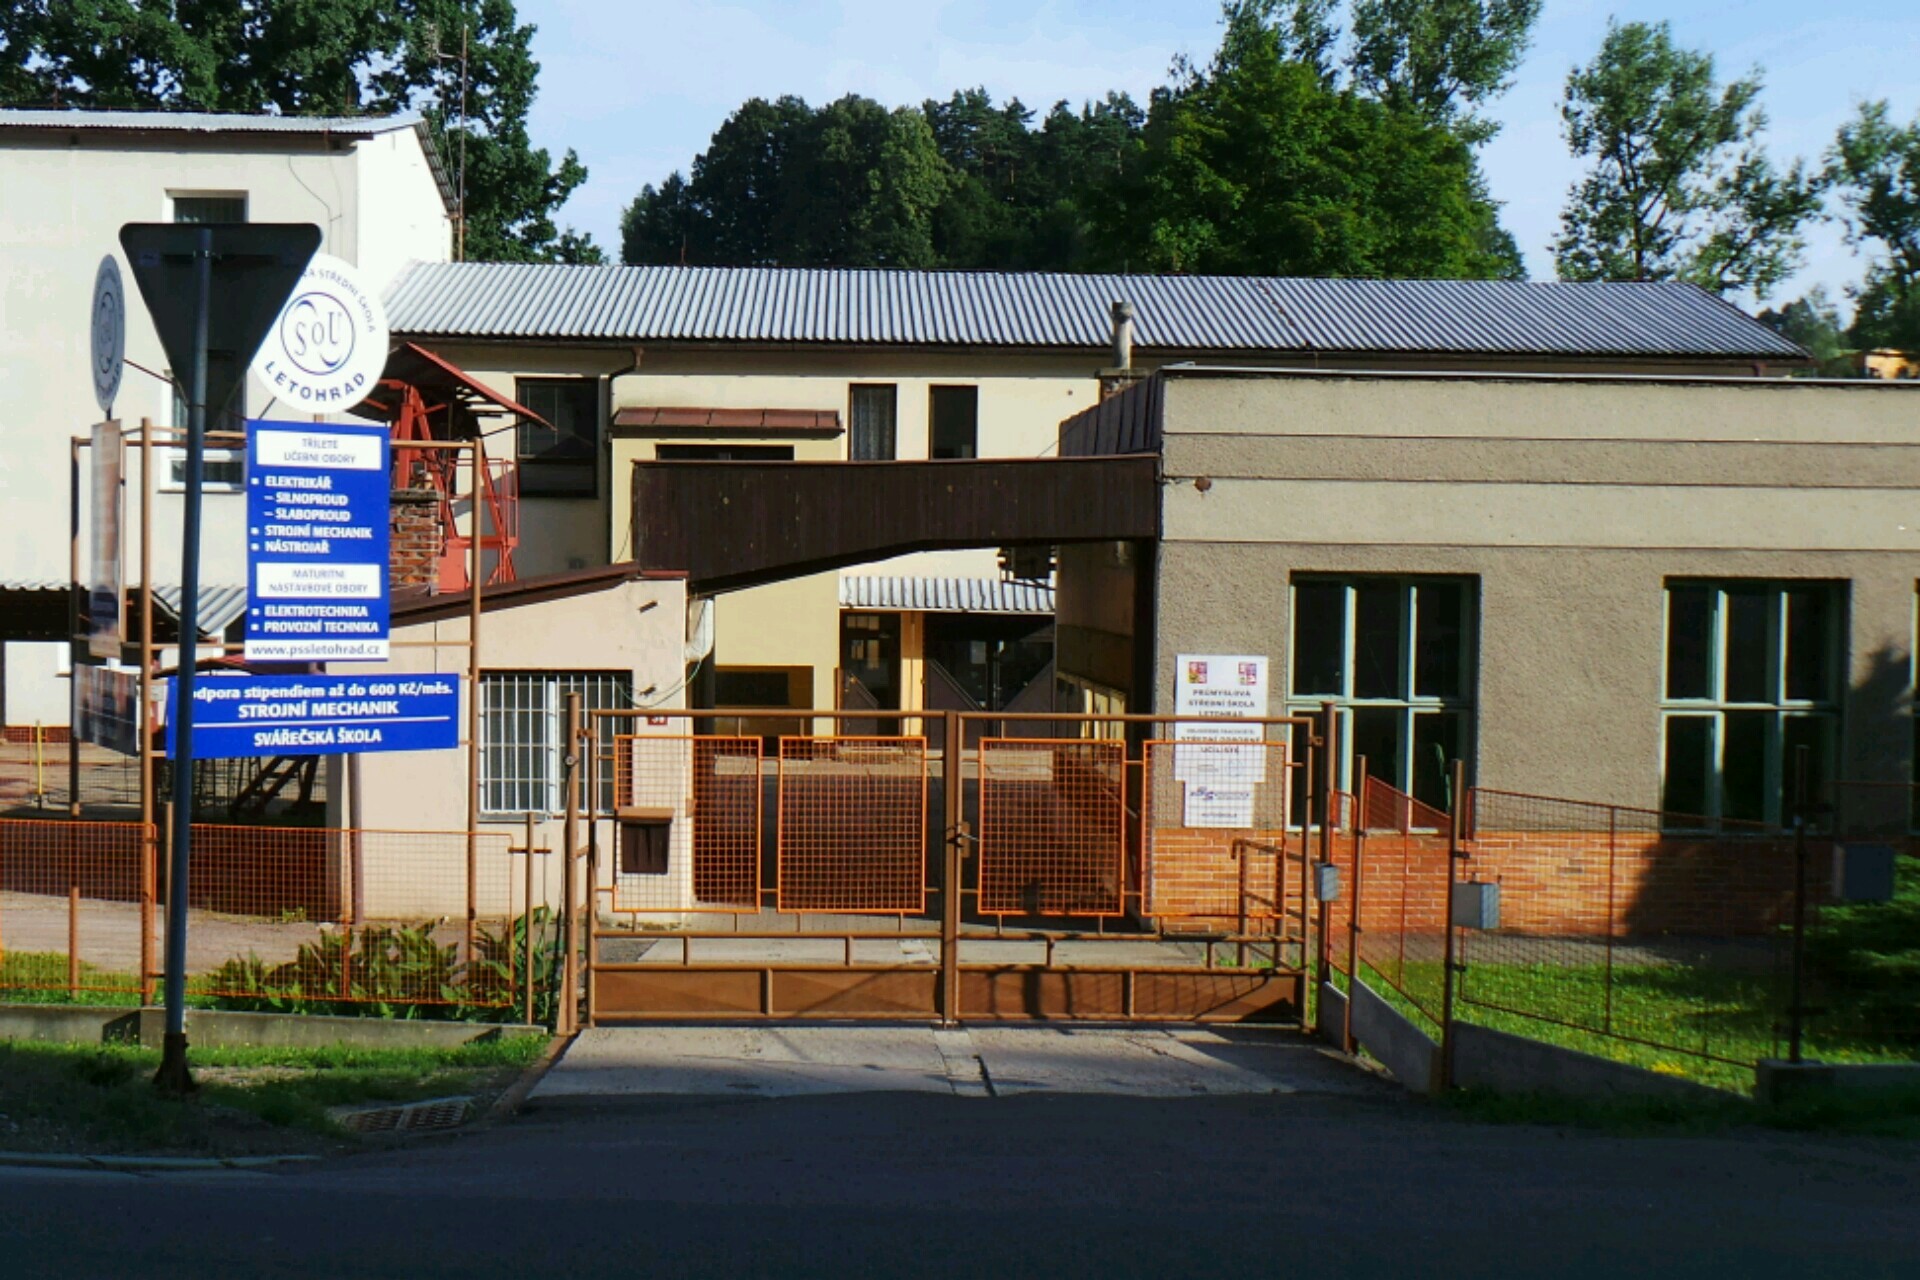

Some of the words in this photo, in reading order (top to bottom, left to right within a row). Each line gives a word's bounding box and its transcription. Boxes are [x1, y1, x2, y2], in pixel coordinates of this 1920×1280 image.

[264, 360, 366, 402] LETOHRAD
[321, 453, 356, 464] OBORY
[264, 475, 332, 490] ELEKTRIKÁŘ
[264, 523, 312, 537] STROJNÍ
[313, 527, 373, 539] MECHANIK
[335, 584, 368, 594] OBORY
[264, 604, 369, 617] ELEKTROTECHNIKA
[264, 618, 323, 633] PROVOZNÍ
[324, 621, 380, 633] TECHNIKA
[252, 644, 381, 658] www.pssletohrad.cz
[244, 684, 325, 702] stipendiem
[328, 683, 344, 697] až
[347, 683, 366, 697] do
[369, 683, 396, 696] 600
[399, 681, 453, 696] Kč/měs.
[238, 699, 308, 719] STROJNÍ
[311, 700, 400, 716] MECHANIK
[254, 727, 335, 747] SVÁŘEČSKÁ
[337, 726, 382, 744] ŠKOLA
